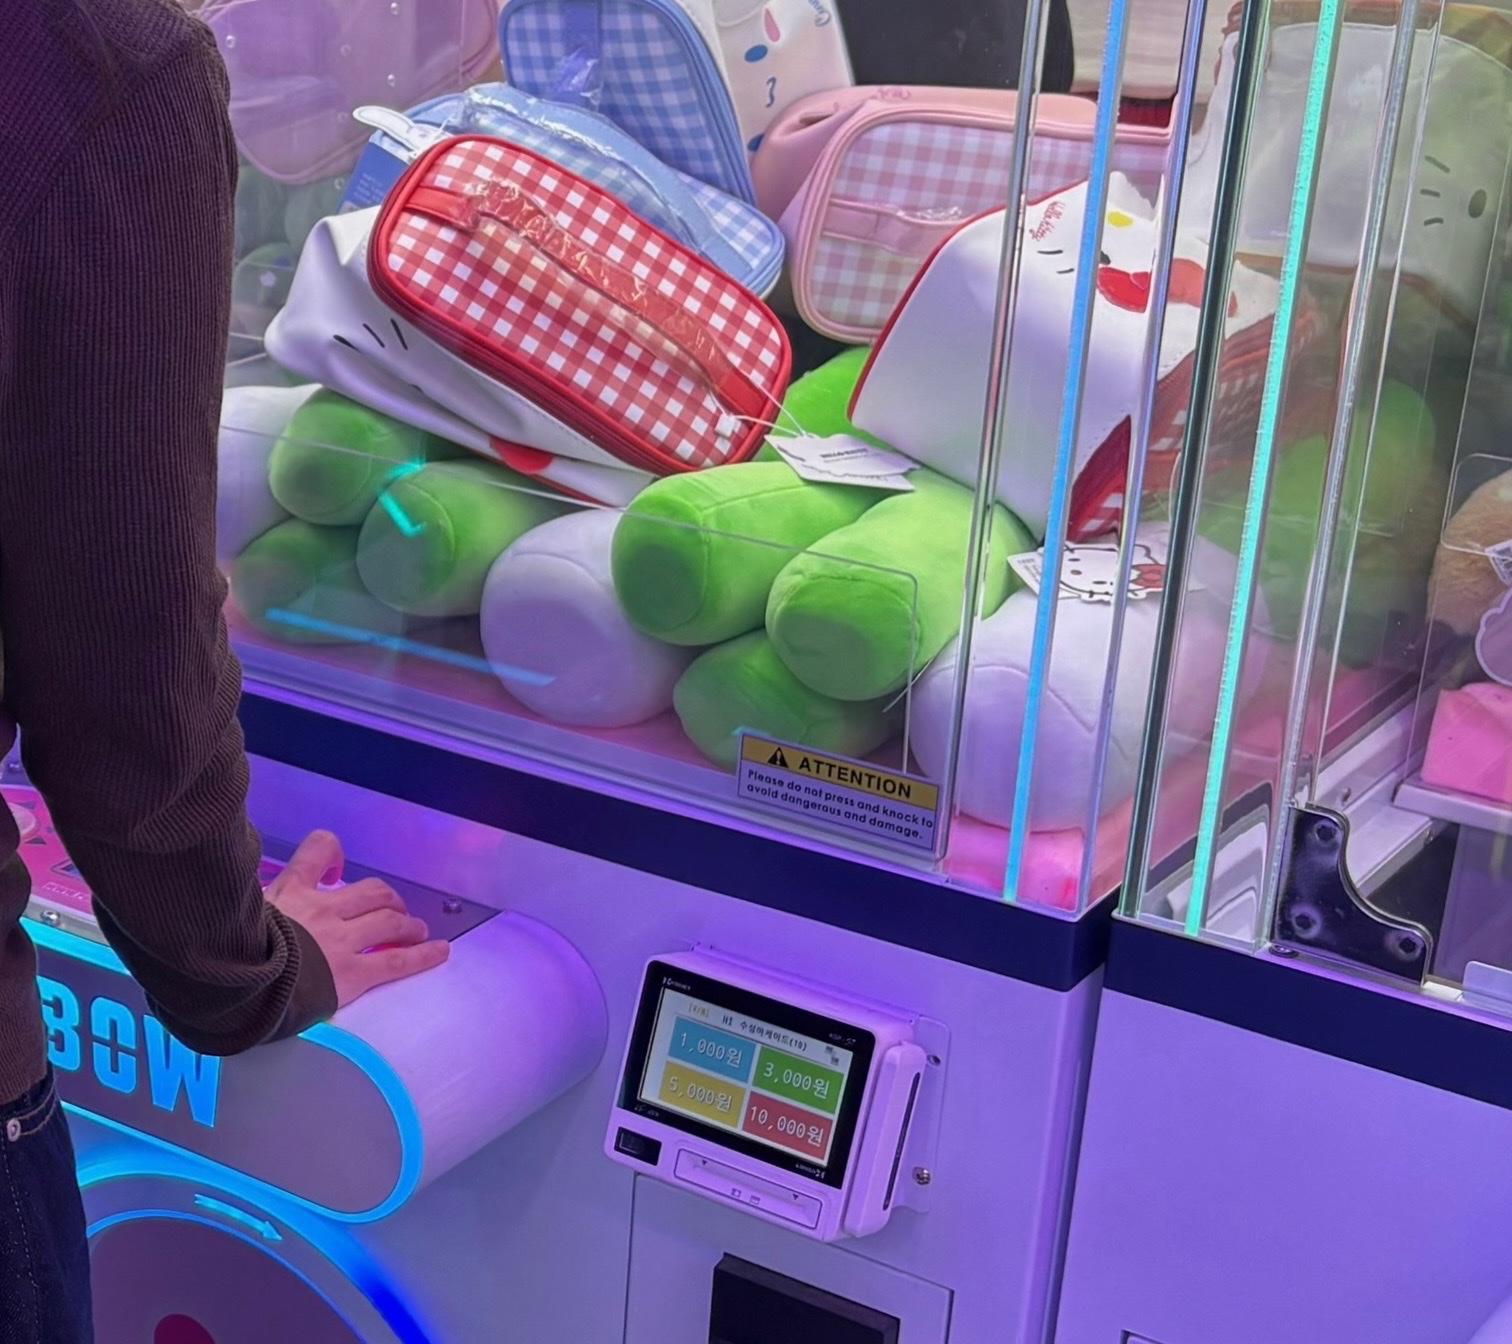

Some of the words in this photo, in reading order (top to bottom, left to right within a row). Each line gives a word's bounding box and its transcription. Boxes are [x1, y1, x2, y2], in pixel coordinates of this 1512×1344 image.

[748, 769, 785, 788] Please
[787, 780, 802, 792] do
[804, 786, 823, 798] not
[824, 791, 855, 807] press
[857, 798, 880, 814] and
[882, 804, 919, 825] knock
[921, 817, 933, 829] to
[799, 757, 912, 798] ATTENTION
[746, 782, 779, 799] avoid
[780, 792, 842, 817] dangerous
[844, 809, 867, 824] and
[869, 813, 923, 840] damage.
[679, 1032, 743, 1069] 1,000원
[763, 1062, 831, 1100] 3,000원
[668, 1076, 734, 1114] 5,000원
[749, 1106, 825, 1148] 10,000원
